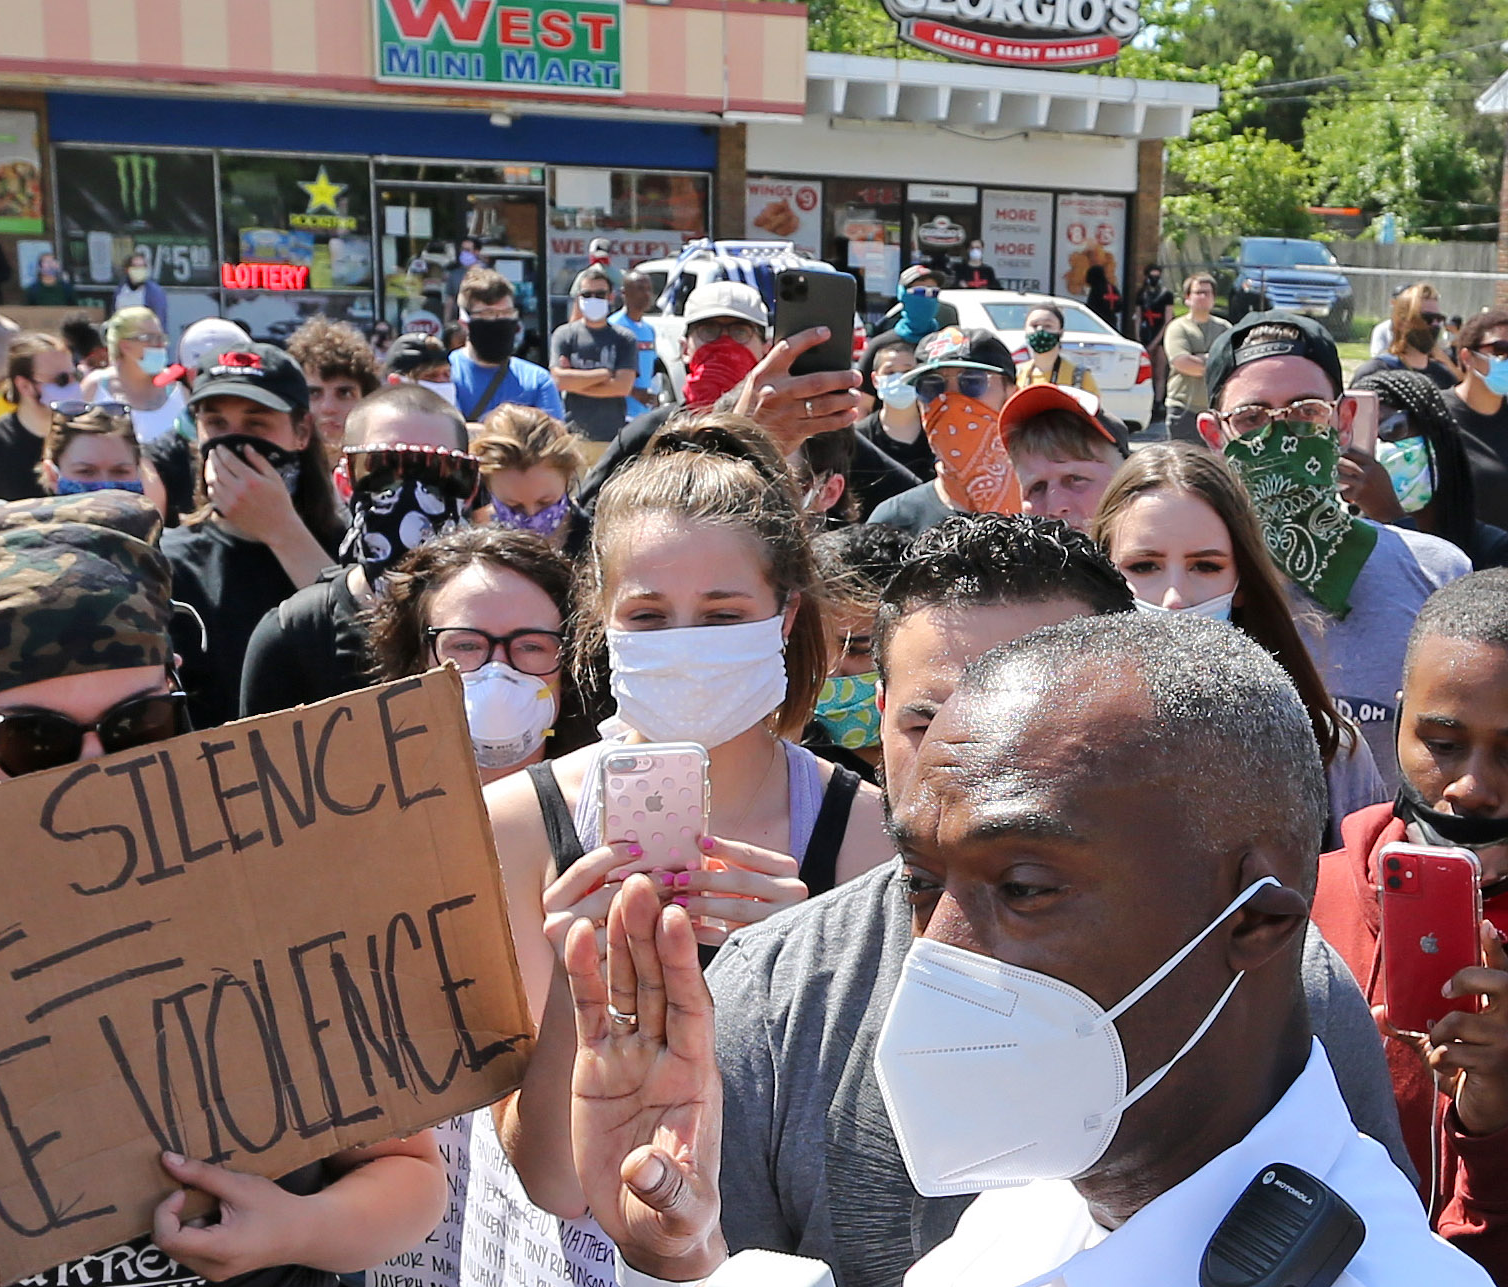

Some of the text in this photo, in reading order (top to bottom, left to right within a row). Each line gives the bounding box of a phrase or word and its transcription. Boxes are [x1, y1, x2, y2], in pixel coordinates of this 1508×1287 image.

[933, 29, 977, 50] FRESH
[996, 43, 1041, 59] READY
[1045, 43, 1099, 59] MARKET
[383, 42, 620, 86] MINI MART
[747, 183, 794, 197] WINGS
[995, 208, 1036, 222] MORE
[550, 238, 585, 255] WE
[994, 242, 1036, 256] MORE
[222, 262, 310, 290] LOTTERY
[40, 679, 447, 895] SILENCE
[100, 894, 537, 1165] VIOLENCE
